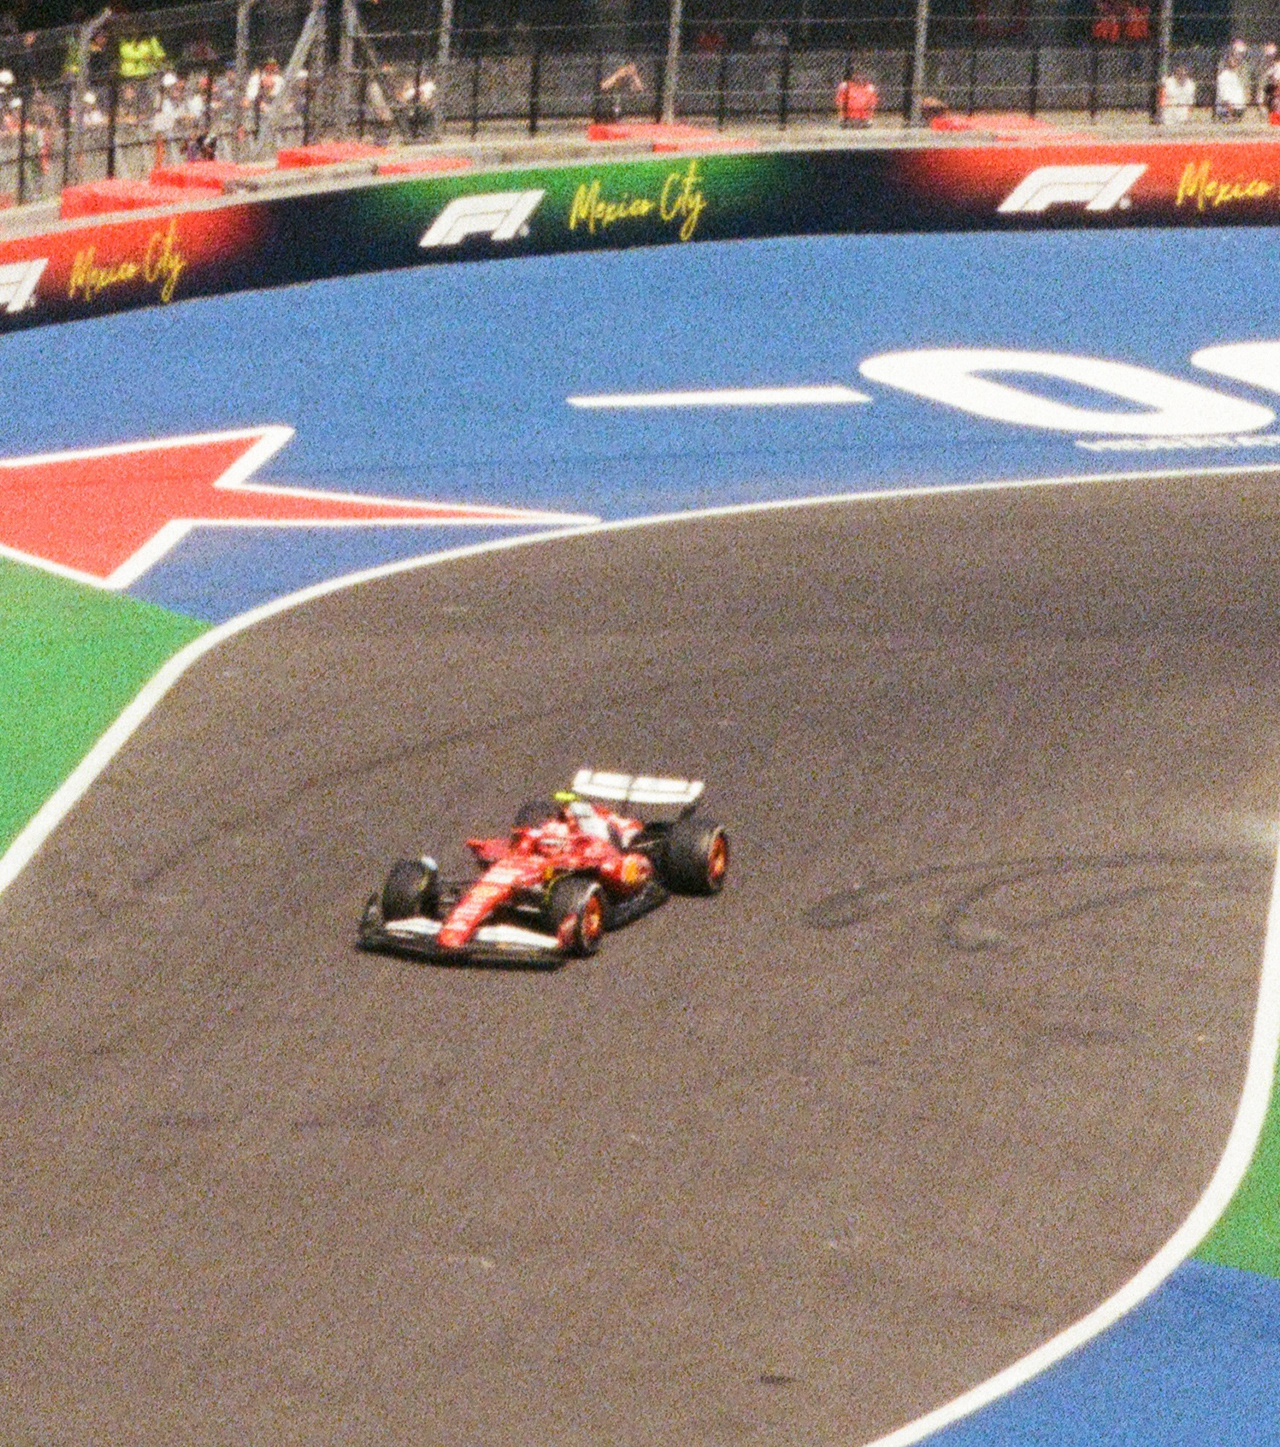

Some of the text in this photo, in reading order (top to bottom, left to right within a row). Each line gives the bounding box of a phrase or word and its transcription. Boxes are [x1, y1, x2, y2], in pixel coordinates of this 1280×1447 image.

[569, 179, 653, 234] Mexico
[660, 160, 708, 241] City
[1176, 159, 1273, 212] Mexico
[69, 245, 139, 302] Mexico
[145, 217, 187, 303] City
